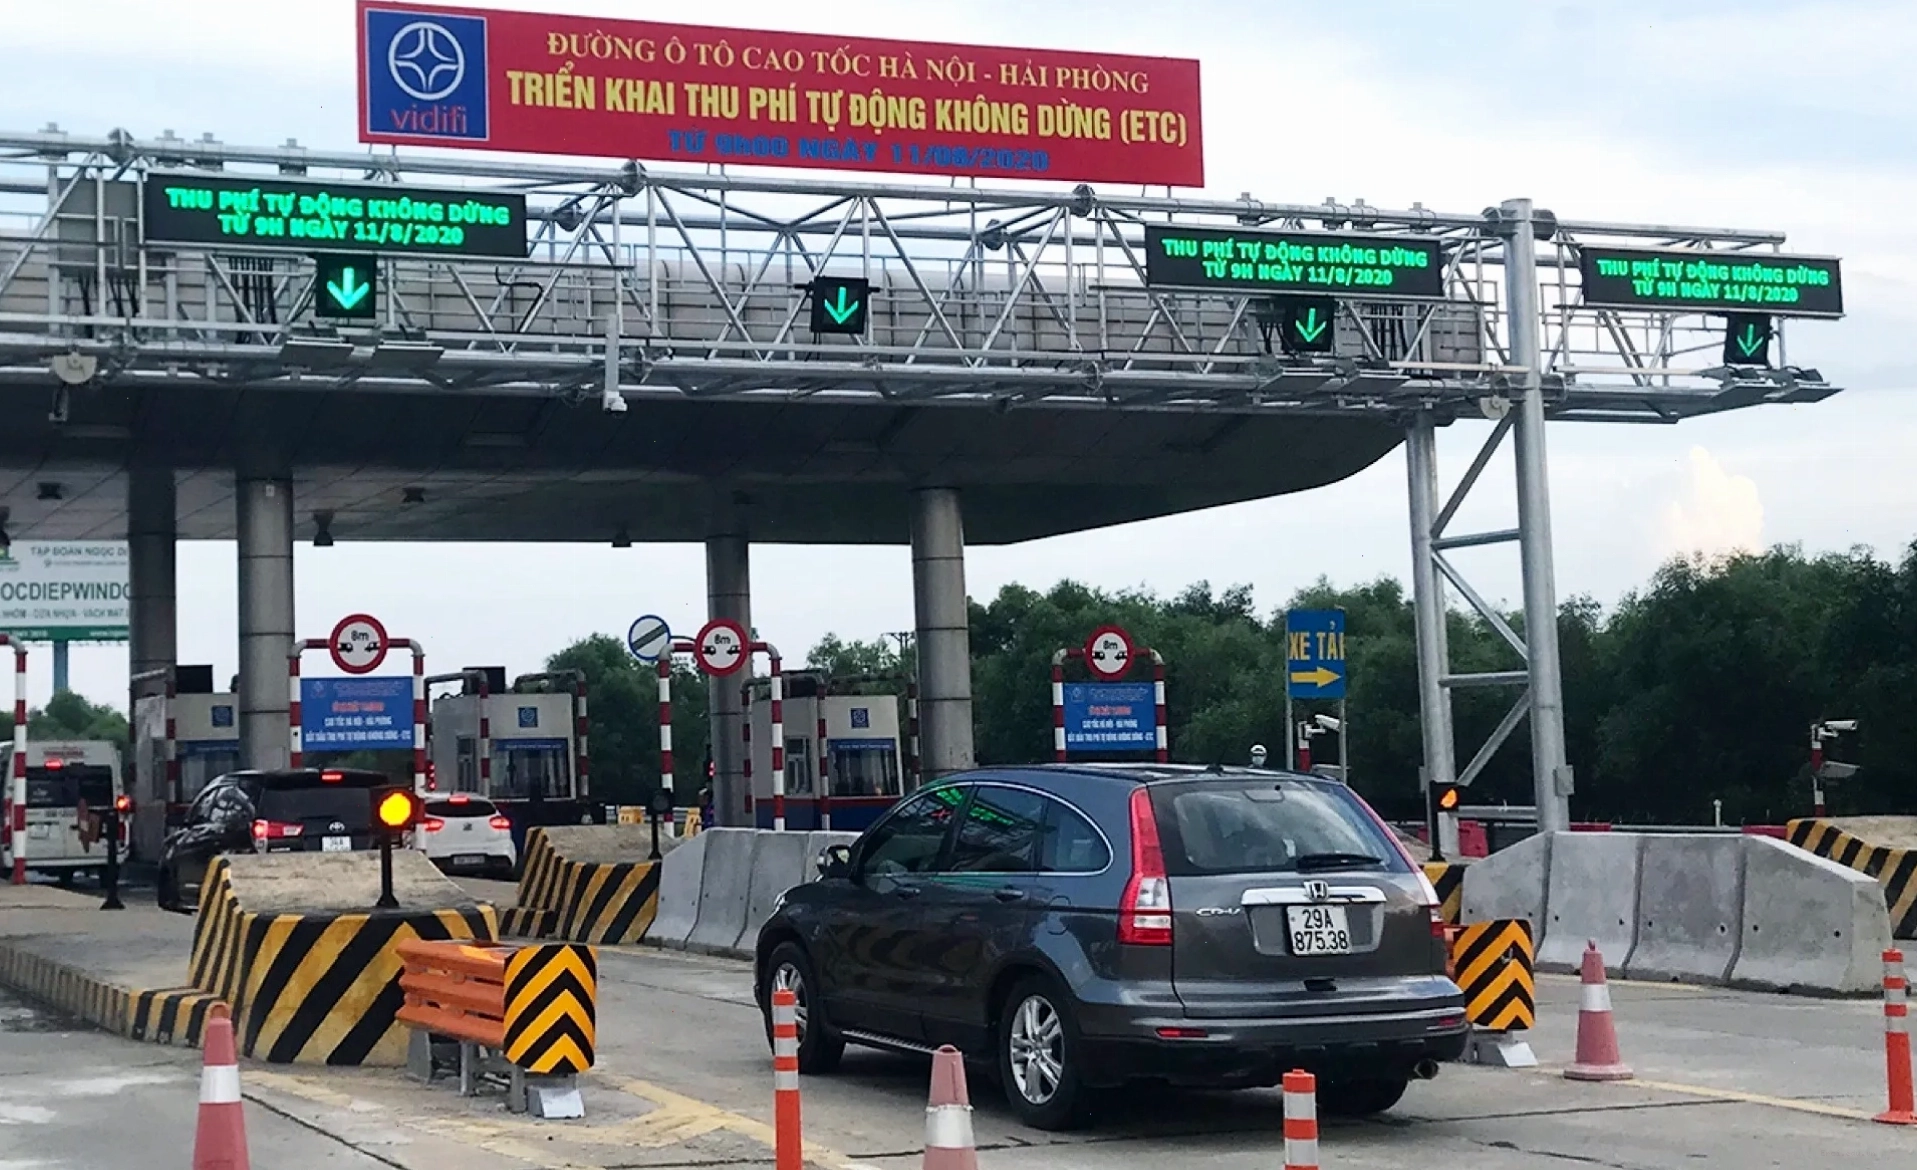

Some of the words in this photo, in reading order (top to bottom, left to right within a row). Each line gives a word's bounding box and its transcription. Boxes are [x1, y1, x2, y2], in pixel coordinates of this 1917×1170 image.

[547, 30, 656, 62] ĐƯỜNG
[664, 35, 687, 65] Ô
[694, 39, 735, 68] TÔ
[742, 46, 804, 71] CAO
[811, 44, 870, 77] TỐC
[879, 51, 918, 79] HÀ
[926, 55, 976, 87] NỘI
[1000, 56, 1048, 88] HẢI
[1056, 66, 1150, 94] PHÒNG
[390, 103, 467, 134] vidifi
[506, 61, 596, 110] TRIỂN
[605, 77, 674, 115] KHAI
[684, 83, 739, 119] THU
[749, 82, 797, 122] PHÍ
[806, 88, 844, 132] TỰ
[849, 88, 926, 134] ĐỘNG
[935, 94, 1029, 135] KHÔNG
[1038, 94, 1111, 140] DỪNG
[1120, 109, 1188, 146] (ETC)
[668, 126, 707, 154] TỪ
[715, 133, 789, 158] 9h00
[798, 136, 877, 162] NGÀY
[891, 143, 1048, 172] 11/08/2020
[165, 187, 212, 209] THU
[219, 188, 259, 212] PHÍ
[263, 192, 295, 217] TỰ
[299, 192, 363, 217] ĐỘNG
[368, 197, 444, 222] KHÔNG
[448, 200, 510, 225] DỪNG
[218, 211, 250, 235] TỪ
[255, 217, 284, 236] 9H
[290, 215, 348, 239] NGÀY
[354, 221, 464, 245] 11/8/2020
[1162, 239, 1198, 257] THU
[1202, 239, 1233, 259] PHÍ
[1237, 241, 1260, 263] TỰ
[1265, 241, 1314, 263] ĐỘNG
[1318, 244, 1376, 265] KHÔNG
[1381, 247, 1428, 267] DỪNG
[1203, 260, 1227, 278] TỪ
[1231, 263, 1252, 279] 9H
[1259, 262, 1303, 282] NGÀY
[1308, 268, 1393, 286] 11/8/2020
[1597, 259, 1628, 276] THU
[1632, 258, 1659, 278] PHÍ
[1662, 261, 1684, 281] TỰ
[1686, 260, 1729, 282] ĐỘNG
[1732, 263, 1783, 283] KHÔNG
[1787, 265, 1829, 286] DỪNG
[1633, 278, 1653, 296] TỪ
[1657, 283, 1676, 298] 9H
[1681, 280, 1719, 299] NGÀY
[1724, 285, 1798, 303] 11/8/2020
[1289, 632, 1311, 660] XE
[1316, 620, 1345, 660] TẢI
[1302, 908, 1334, 929] 29A
[1294, 930, 1348, 951] 875.38
